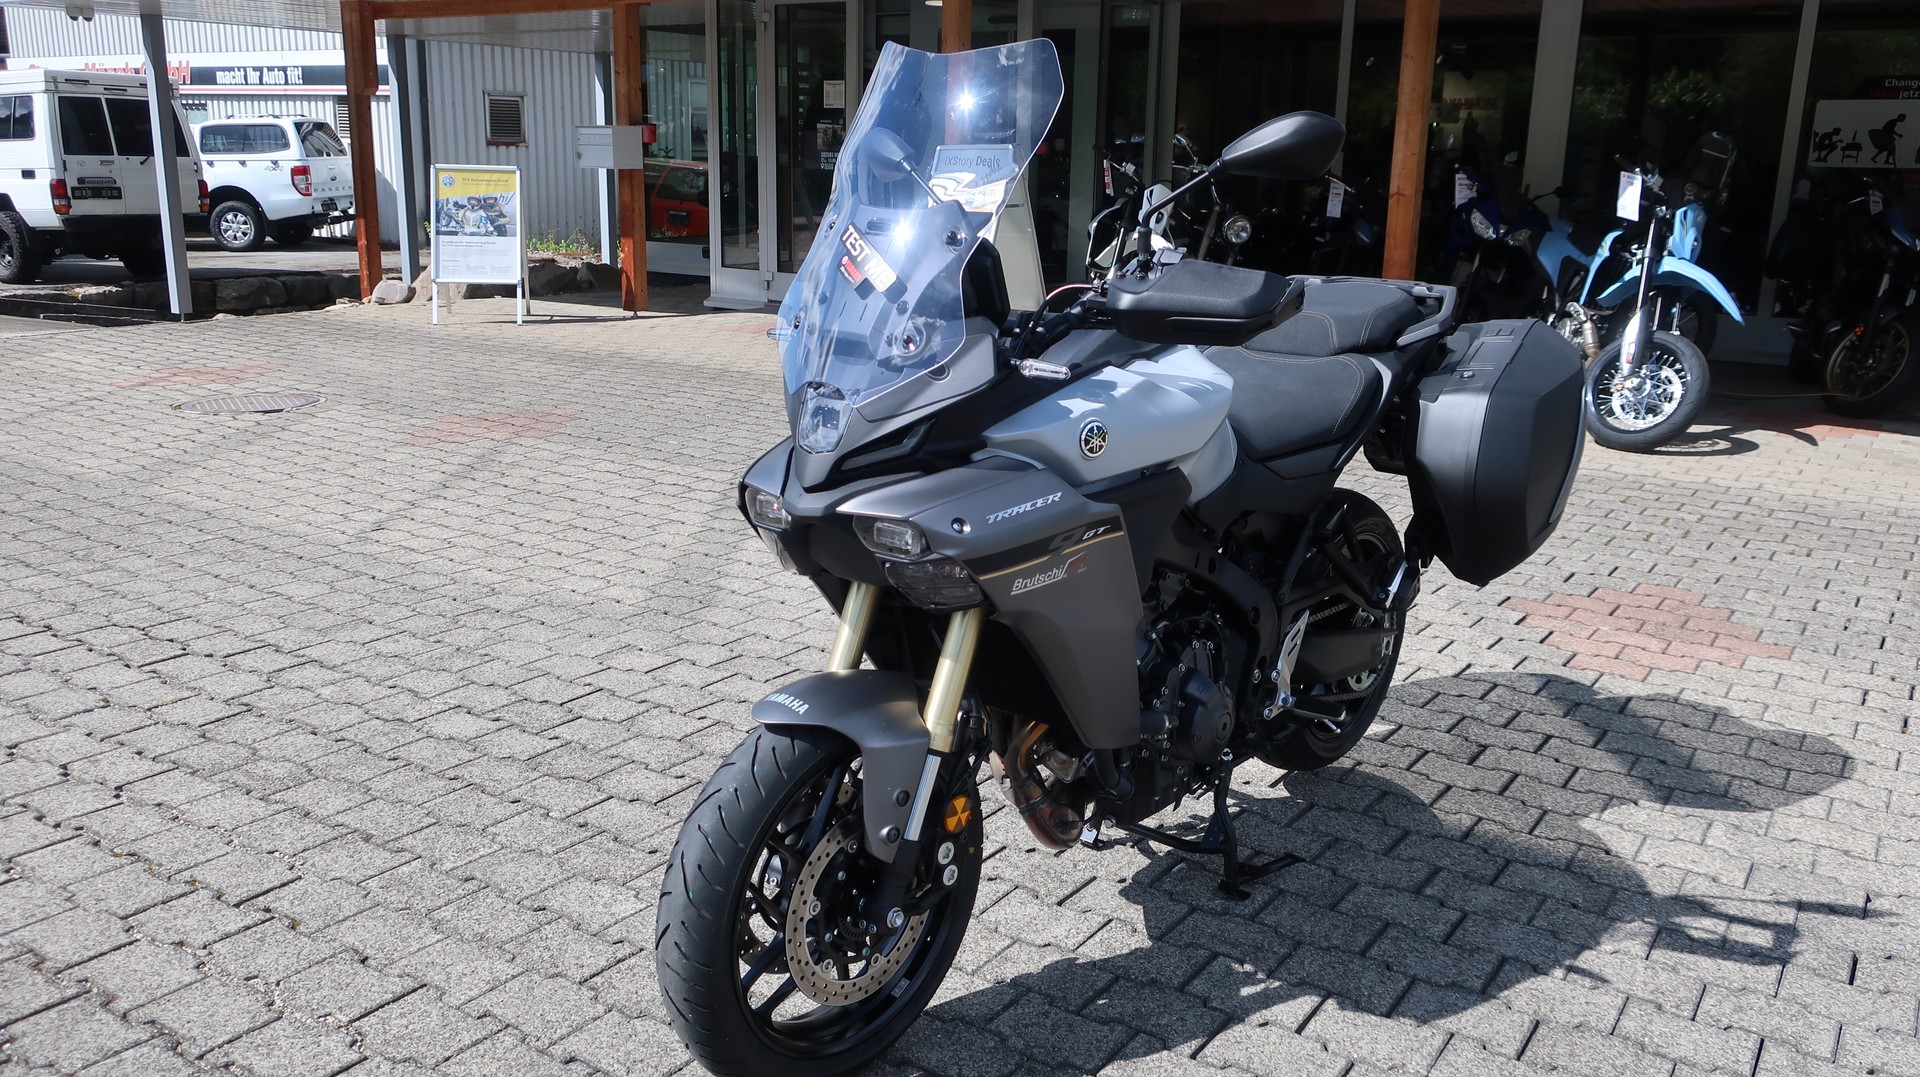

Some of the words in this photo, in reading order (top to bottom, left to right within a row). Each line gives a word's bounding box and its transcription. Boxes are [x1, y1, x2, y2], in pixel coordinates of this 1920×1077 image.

[215, 67, 246, 85] macht
[246, 67, 260, 85] Ihr
[262, 66, 285, 85] Auto
[286, 66, 304, 85] fit!
[1885, 78, 1920, 89] Chang
[313, 185, 353, 193] RANGER
[842, 224, 872, 262] TEST
[863, 256, 895, 291] ME
[985, 491, 1063, 525] TRACER
[1082, 525, 1112, 541] GT
[1011, 565, 1064, 592] Brutschi
[763, 692, 810, 715] YAMAHA
